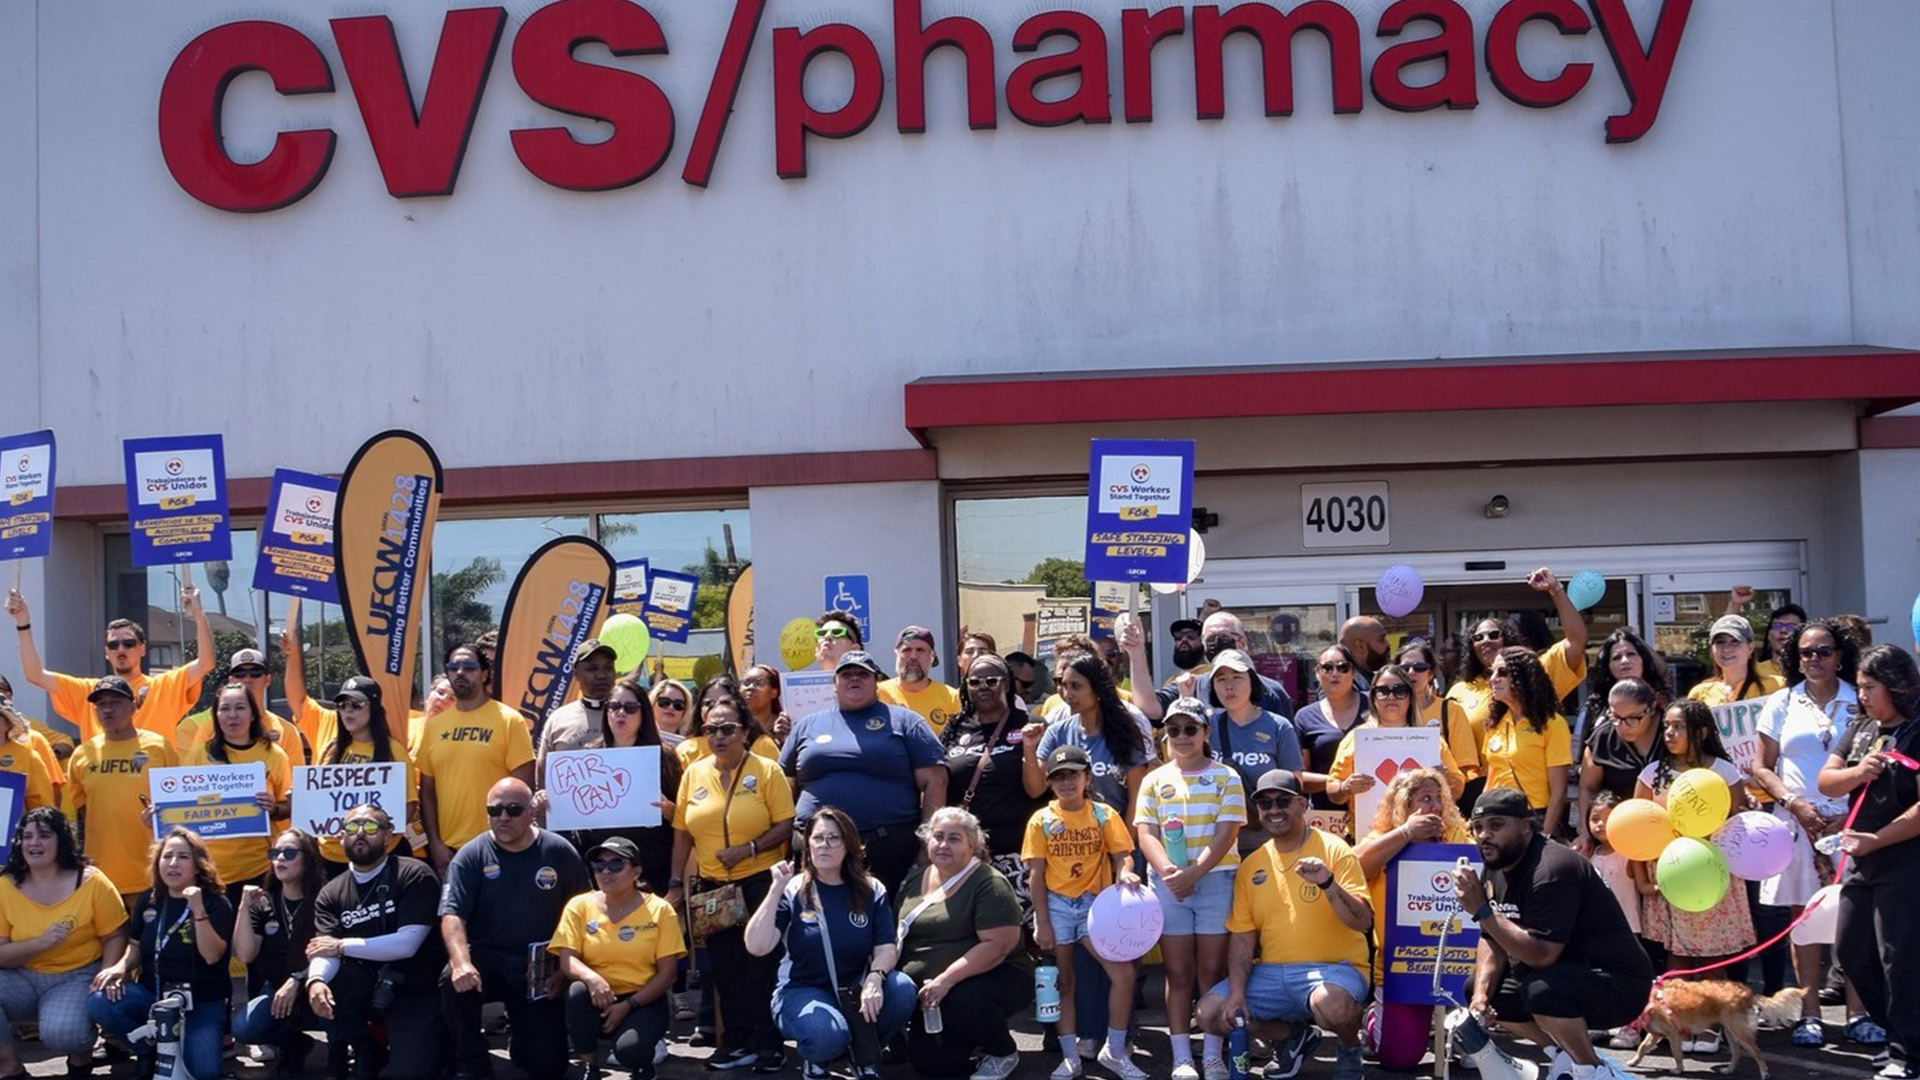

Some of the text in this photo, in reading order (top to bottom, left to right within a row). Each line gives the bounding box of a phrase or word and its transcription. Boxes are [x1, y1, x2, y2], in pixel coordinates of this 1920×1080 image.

[146, 476, 196, 485] Trabajadores
[147, 481, 208, 492] CVS Unidos
[1109, 485, 1171, 494] CVS Workers
[168, 497, 189, 507] POR
[1109, 493, 1171, 502] Stand Together
[1128, 508, 1150, 518] FOR
[1306, 495, 1386, 533] 4030
[283, 514, 334, 532] CVS Unido
[298, 532, 318, 544] POR
[1096, 533, 1181, 544] SAFE STAFFING
[367, 536, 405, 637] UFCW
[387, 474, 418, 542] 1428
[1116, 547, 1158, 556] LEVELS
[389, 478, 429, 674] Building Better Communities
[550, 579, 591, 647] 1428
[452, 727, 493, 743] UFCW
[101, 759, 142, 774] UFCW
[182, 772, 255, 785] CVS Workers
[306, 766, 393, 791] RESPECT
[555, 757, 607, 789] FAIR
[182, 781, 255, 793] Stand Together
[329, 790, 383, 813] YOUR
[184, 807, 239, 820] FAIR PAY
[1407, 901, 1433, 912] CVS
[1397, 948, 1429, 957] PAGO
